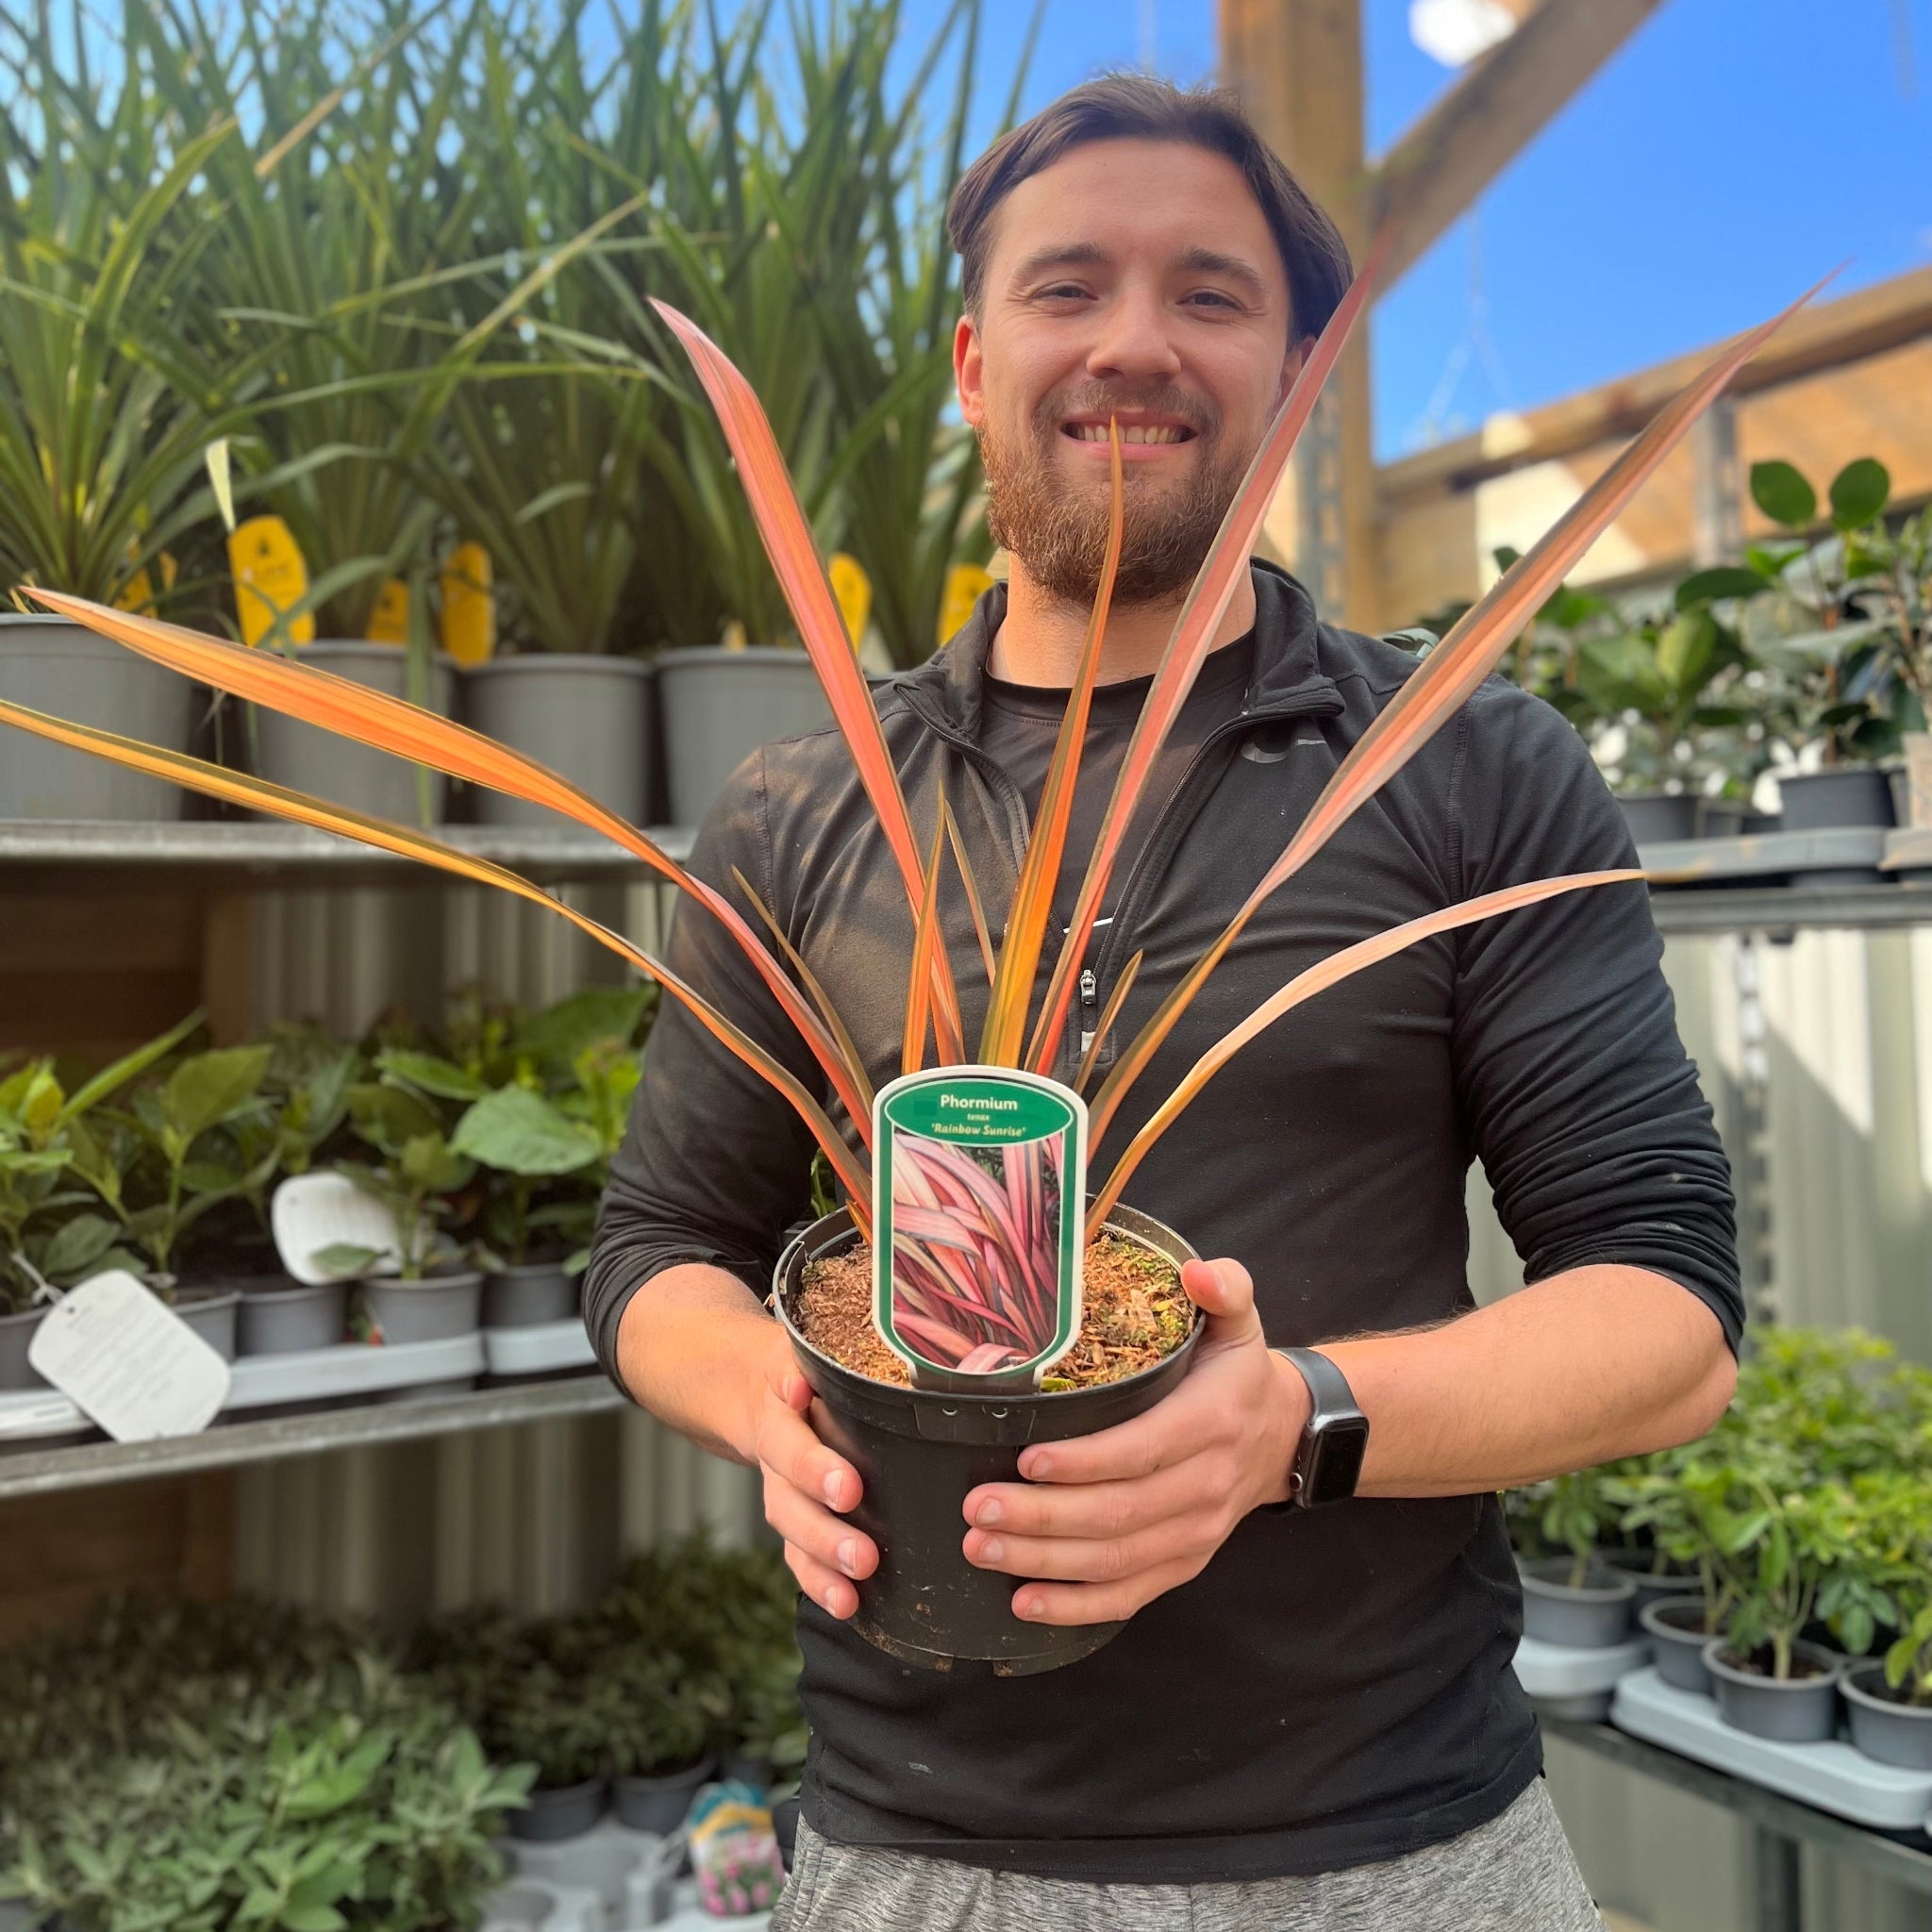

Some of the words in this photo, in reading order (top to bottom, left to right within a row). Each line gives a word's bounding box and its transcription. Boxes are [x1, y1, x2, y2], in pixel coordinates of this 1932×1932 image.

[940, 1093, 1018, 1111] Phormium
[931, 1123, 980, 1135] 'Rainbow
[983, 1124, 1026, 1137] Sunrise'
